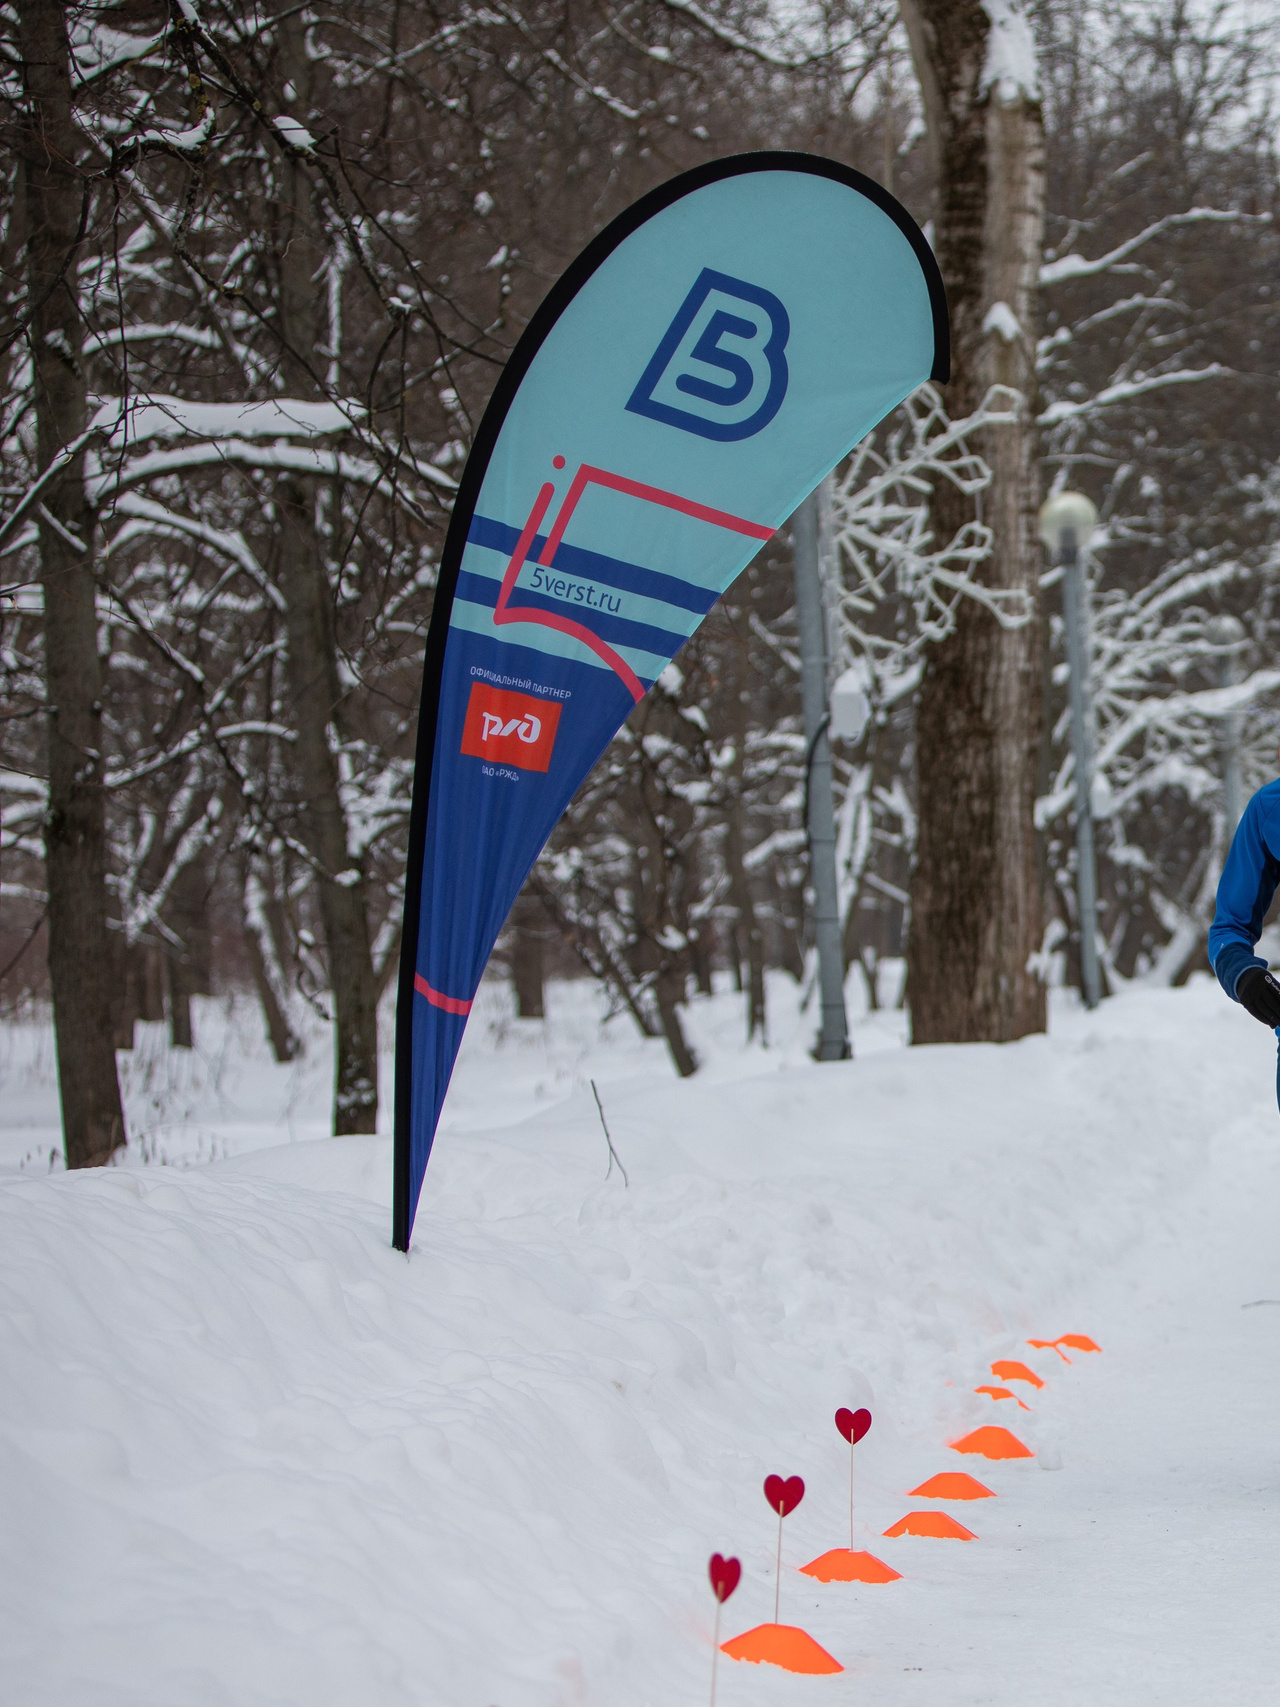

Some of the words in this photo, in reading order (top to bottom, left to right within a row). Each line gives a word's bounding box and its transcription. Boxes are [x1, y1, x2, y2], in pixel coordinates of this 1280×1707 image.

[530, 567, 621, 613] 5verst.ru
[470, 666, 531, 690] ОФИЦИАЛЬНЫЙ
[532, 683, 572, 699] ПАРТНЕР
